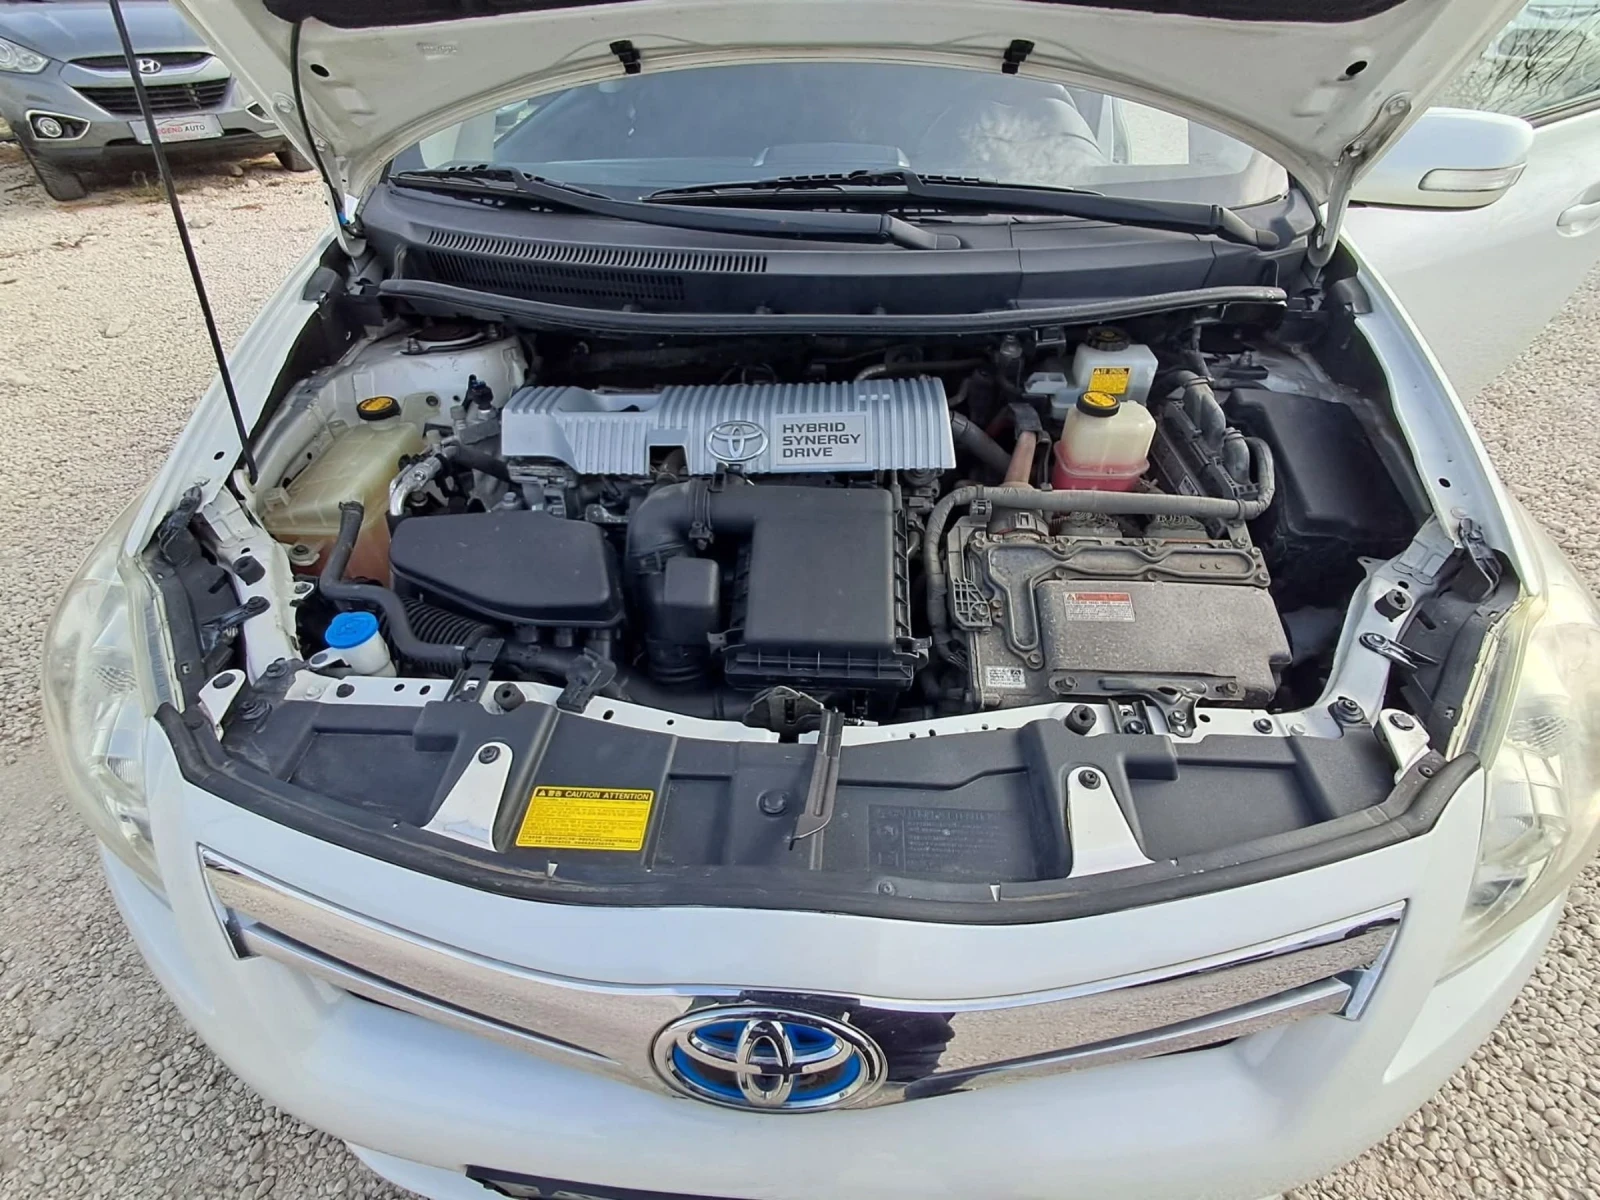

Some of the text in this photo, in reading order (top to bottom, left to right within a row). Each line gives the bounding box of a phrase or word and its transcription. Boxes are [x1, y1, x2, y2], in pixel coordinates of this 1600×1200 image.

[155, 124, 205, 134] GEND AUTO
[782, 422, 846, 434] HYBRID
[782, 434, 861, 446] SYNERGY
[782, 446, 833, 458] DRIVE
[565, 790, 601, 799] CAUTION
[602, 792, 650, 800] ATTENTION
